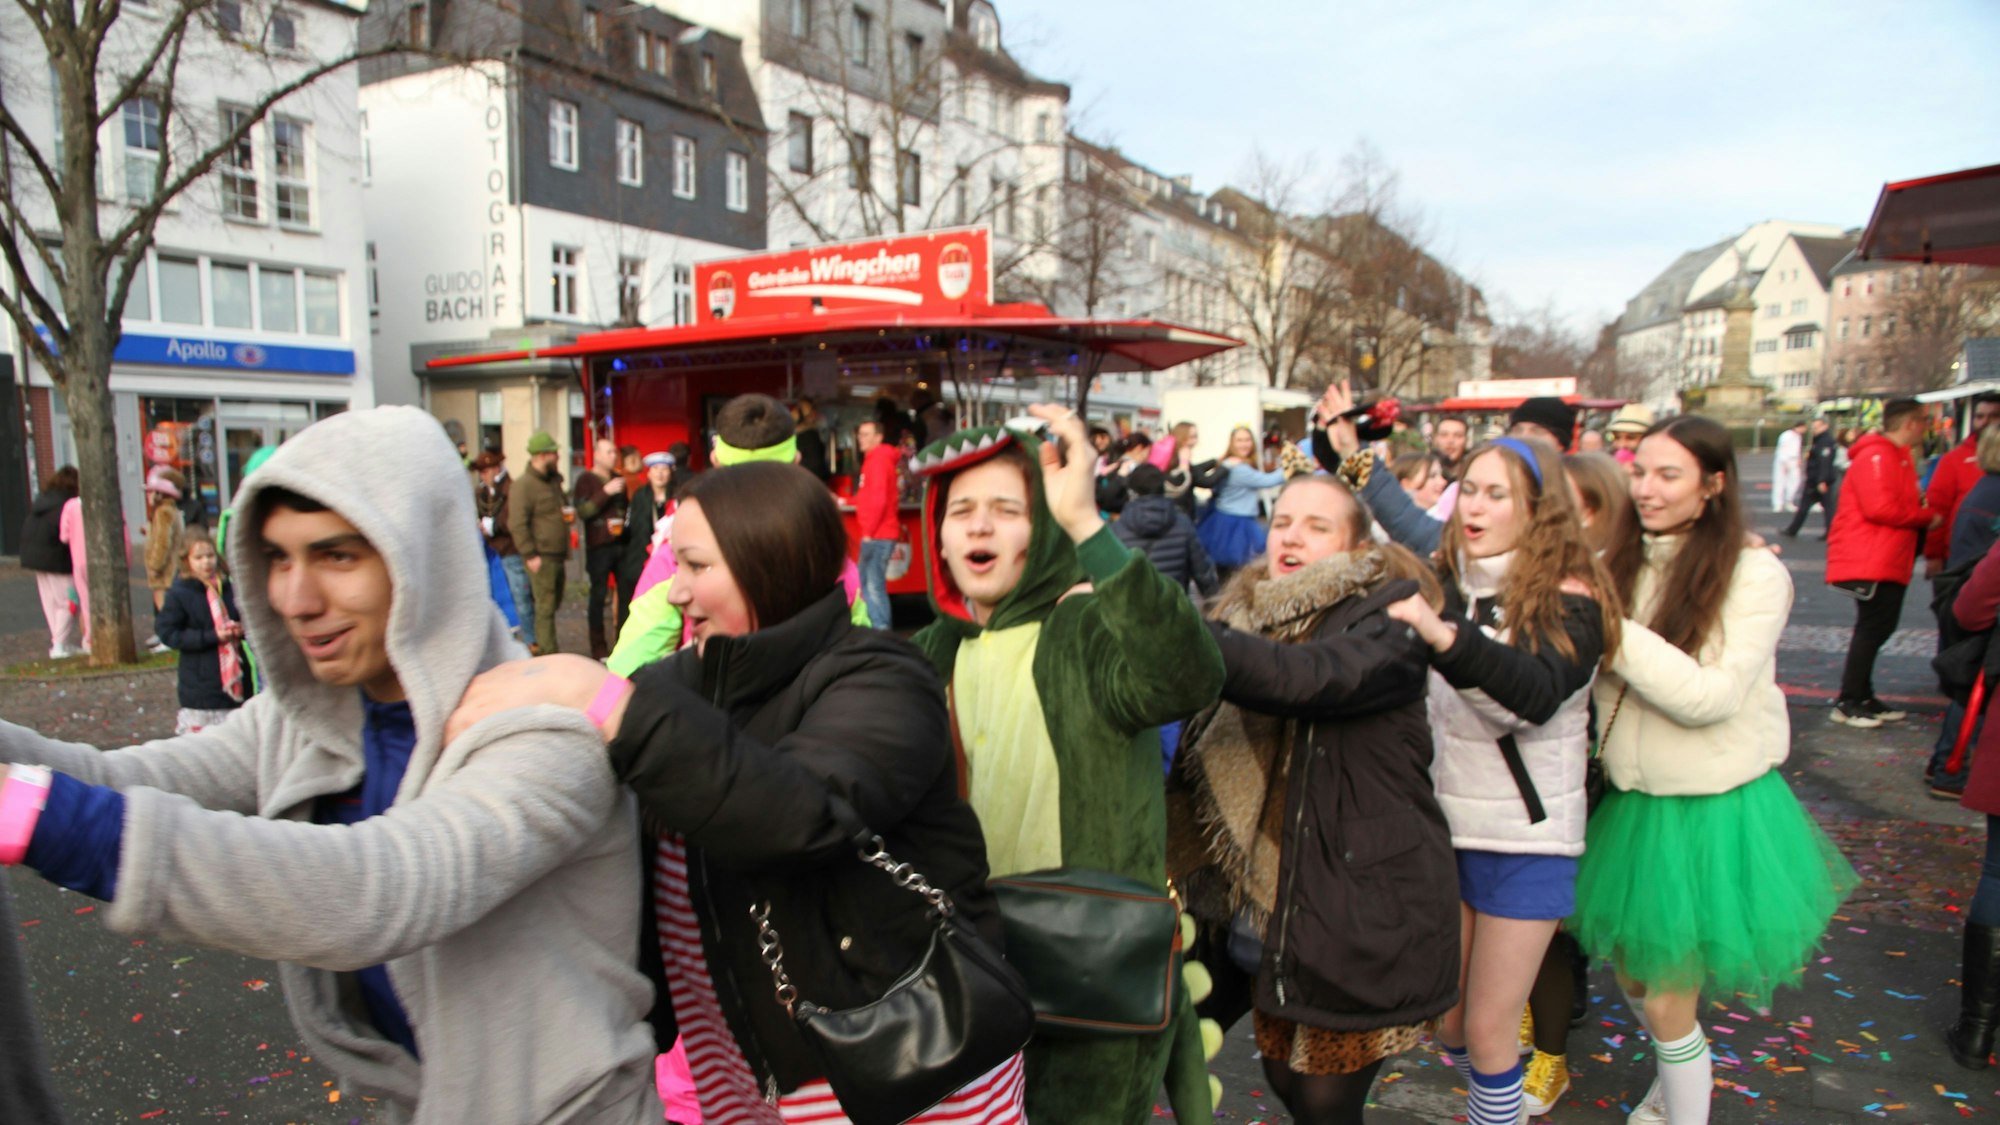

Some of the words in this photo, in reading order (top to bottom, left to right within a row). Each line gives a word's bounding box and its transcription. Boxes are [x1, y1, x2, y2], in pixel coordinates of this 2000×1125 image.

[810, 248, 921, 285] Wingchen
[425, 270, 482, 296] GUIDO
[425, 298, 483, 323] BACH
[166, 337, 228, 362] Apollo
